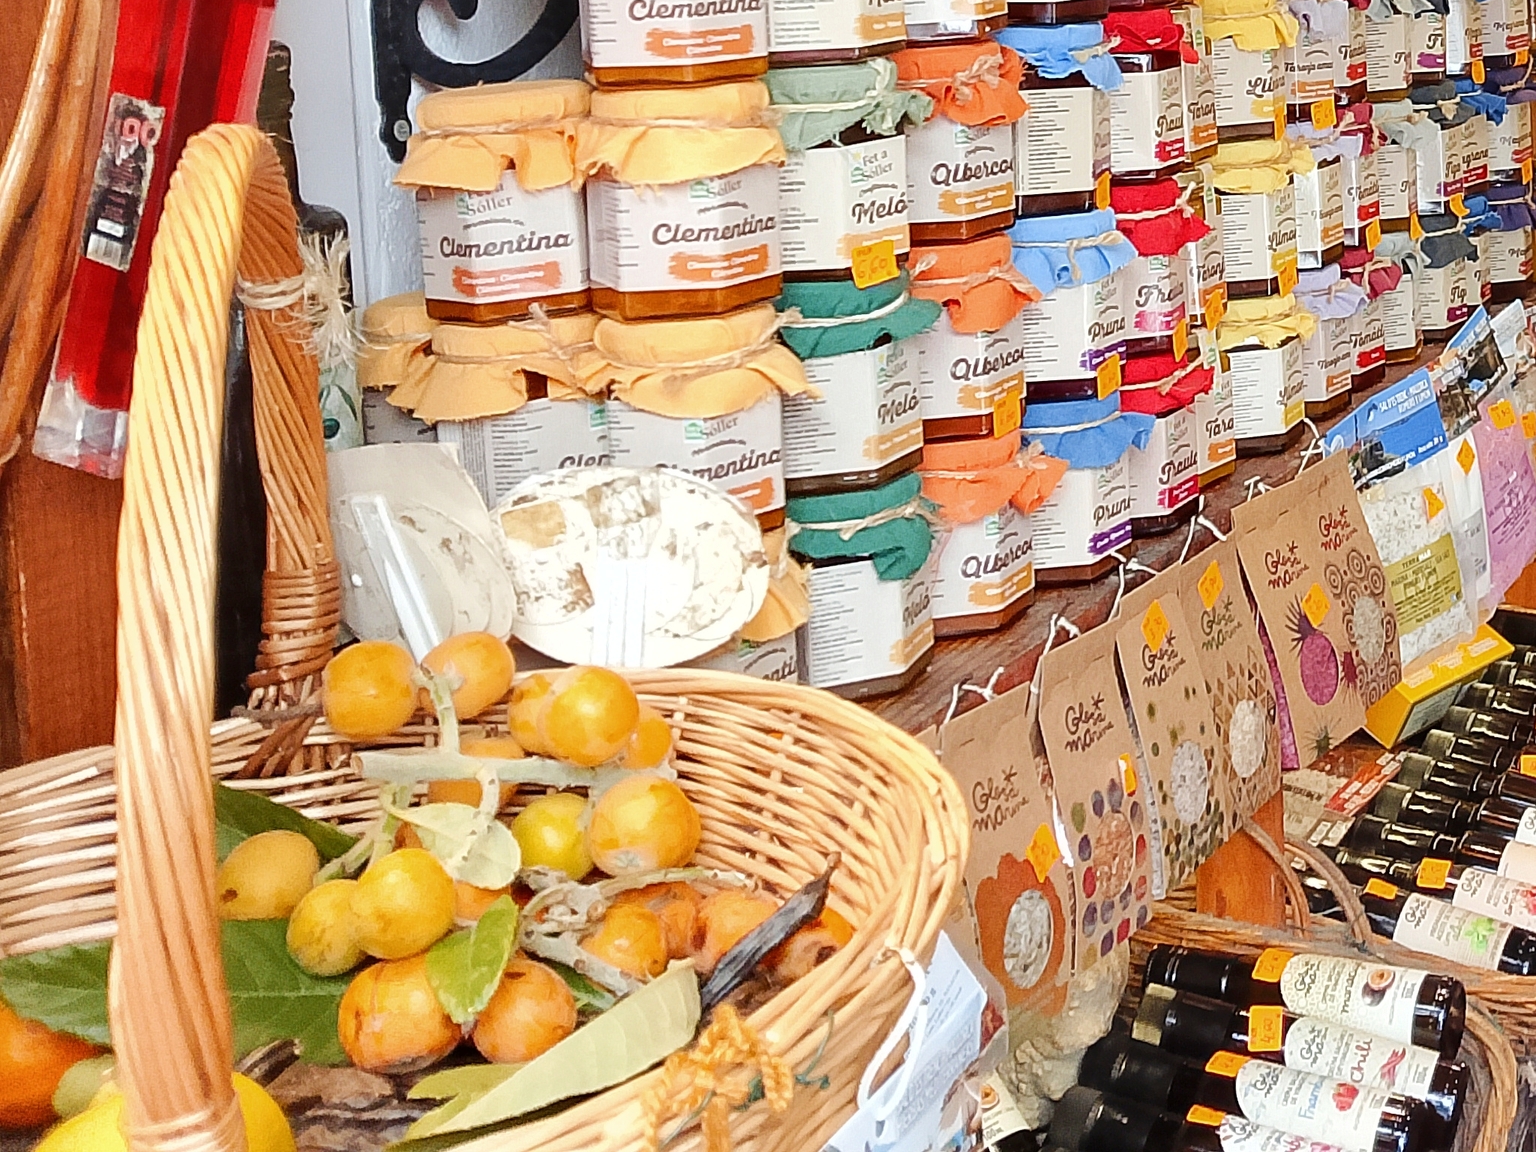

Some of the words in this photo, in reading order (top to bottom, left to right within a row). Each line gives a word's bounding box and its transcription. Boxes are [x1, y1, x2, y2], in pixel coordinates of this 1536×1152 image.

[863, 153, 878, 166] Fet
[466, 195, 513, 217] Sóller
[852, 193, 909, 225] Meló
[439, 231, 574, 260] Clementina
[652, 214, 777, 246] Clementina
[877, 389, 919, 425] Meló
[1206, 417, 1234, 438] Taro
[902, 589, 930, 626] Meló
[1351, 1038, 1373, 1084] Chili
[1298, 1076, 1326, 1120] Framb
